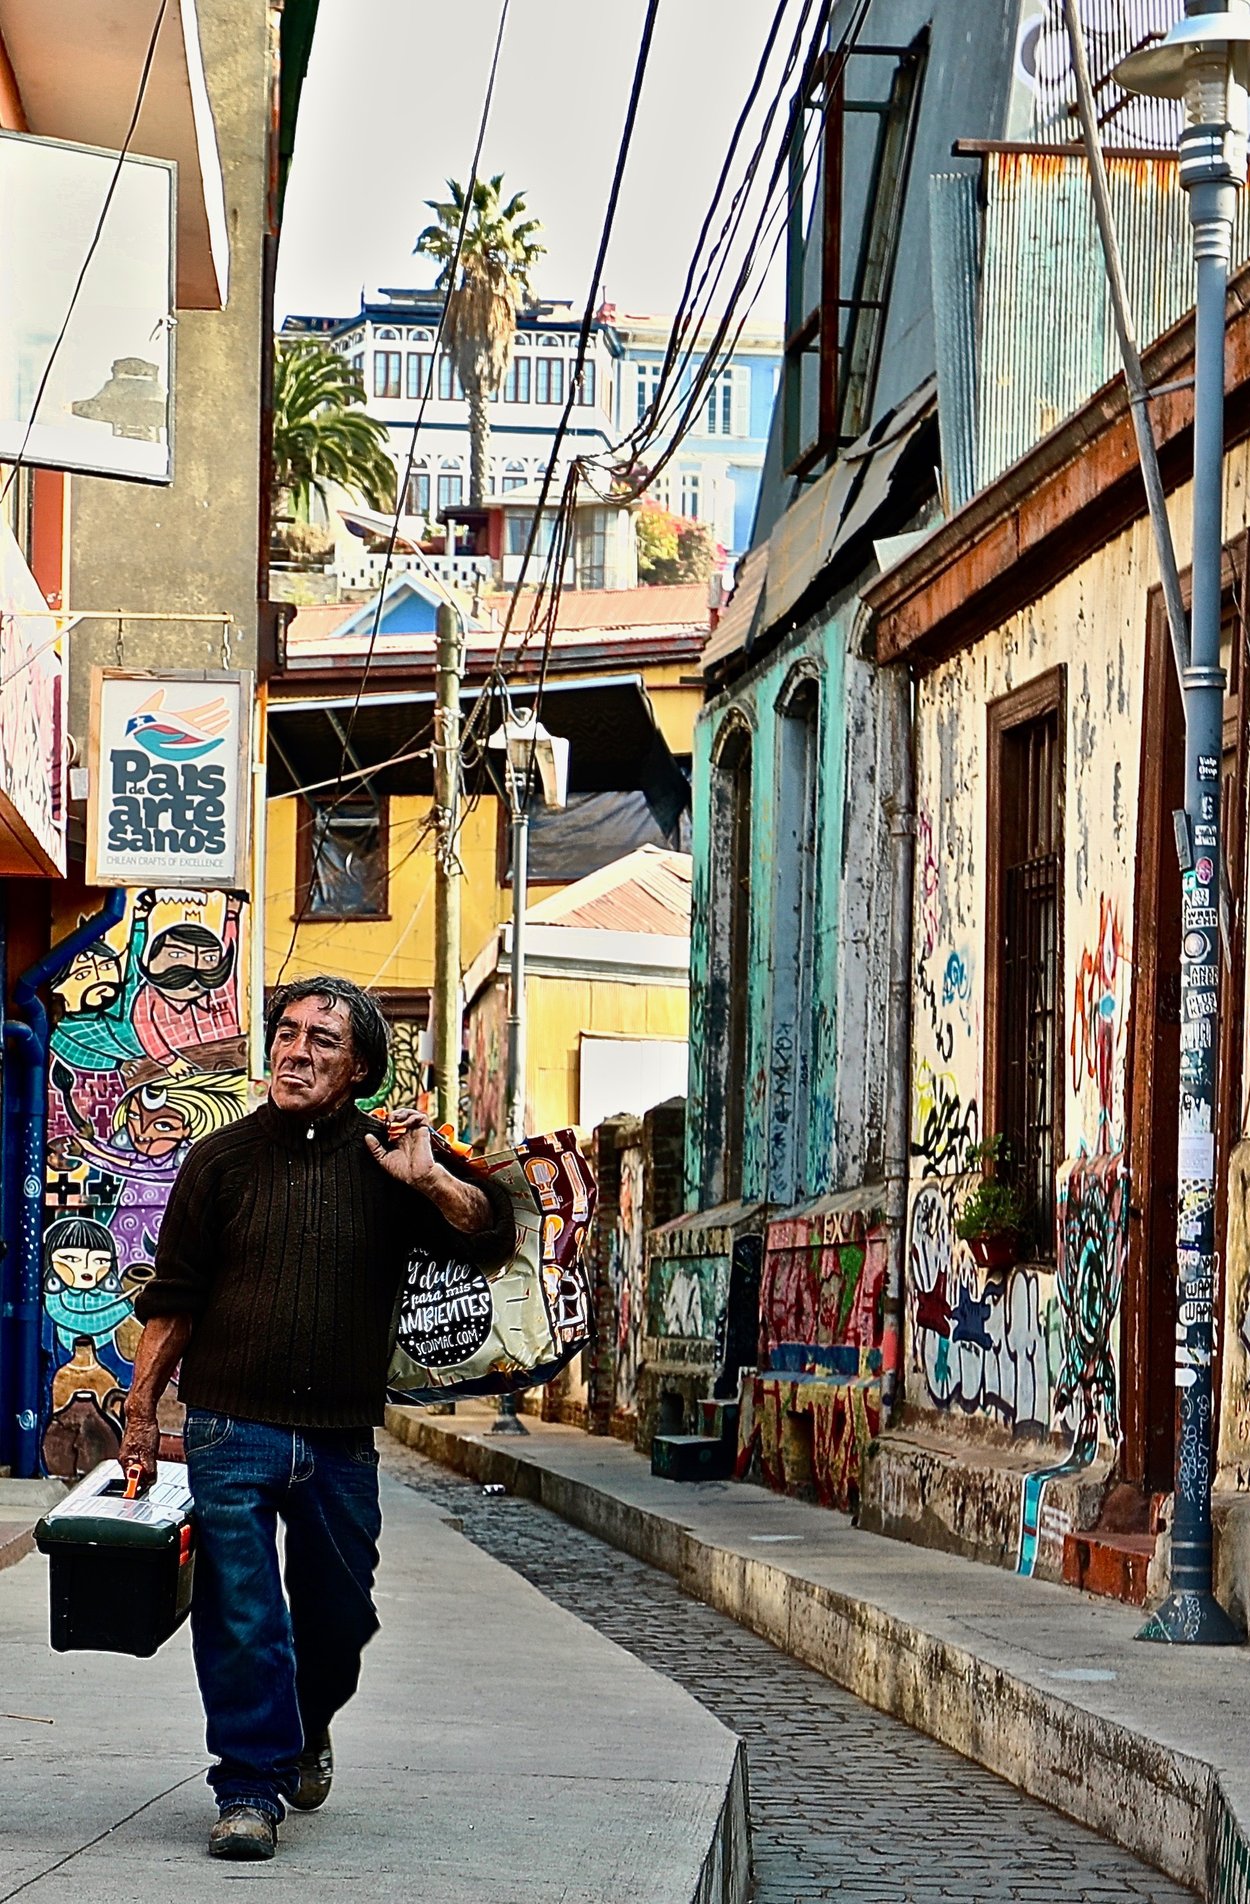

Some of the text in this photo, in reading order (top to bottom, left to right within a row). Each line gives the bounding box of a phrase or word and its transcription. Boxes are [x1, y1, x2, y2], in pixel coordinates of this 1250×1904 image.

[128, 781, 145, 795] de
[108, 795, 226, 831] arte
[107, 826, 226, 854] sanos
[106, 856, 224, 868] CHILEAN CRAFTS OF EXCELLENCE
[420, 1259, 472, 1290] dulce
[411, 1281, 472, 1310] para mis
[398, 1293, 490, 1334] AMBIENTES
[415, 1328, 479, 1356] SODIMAC.COM
